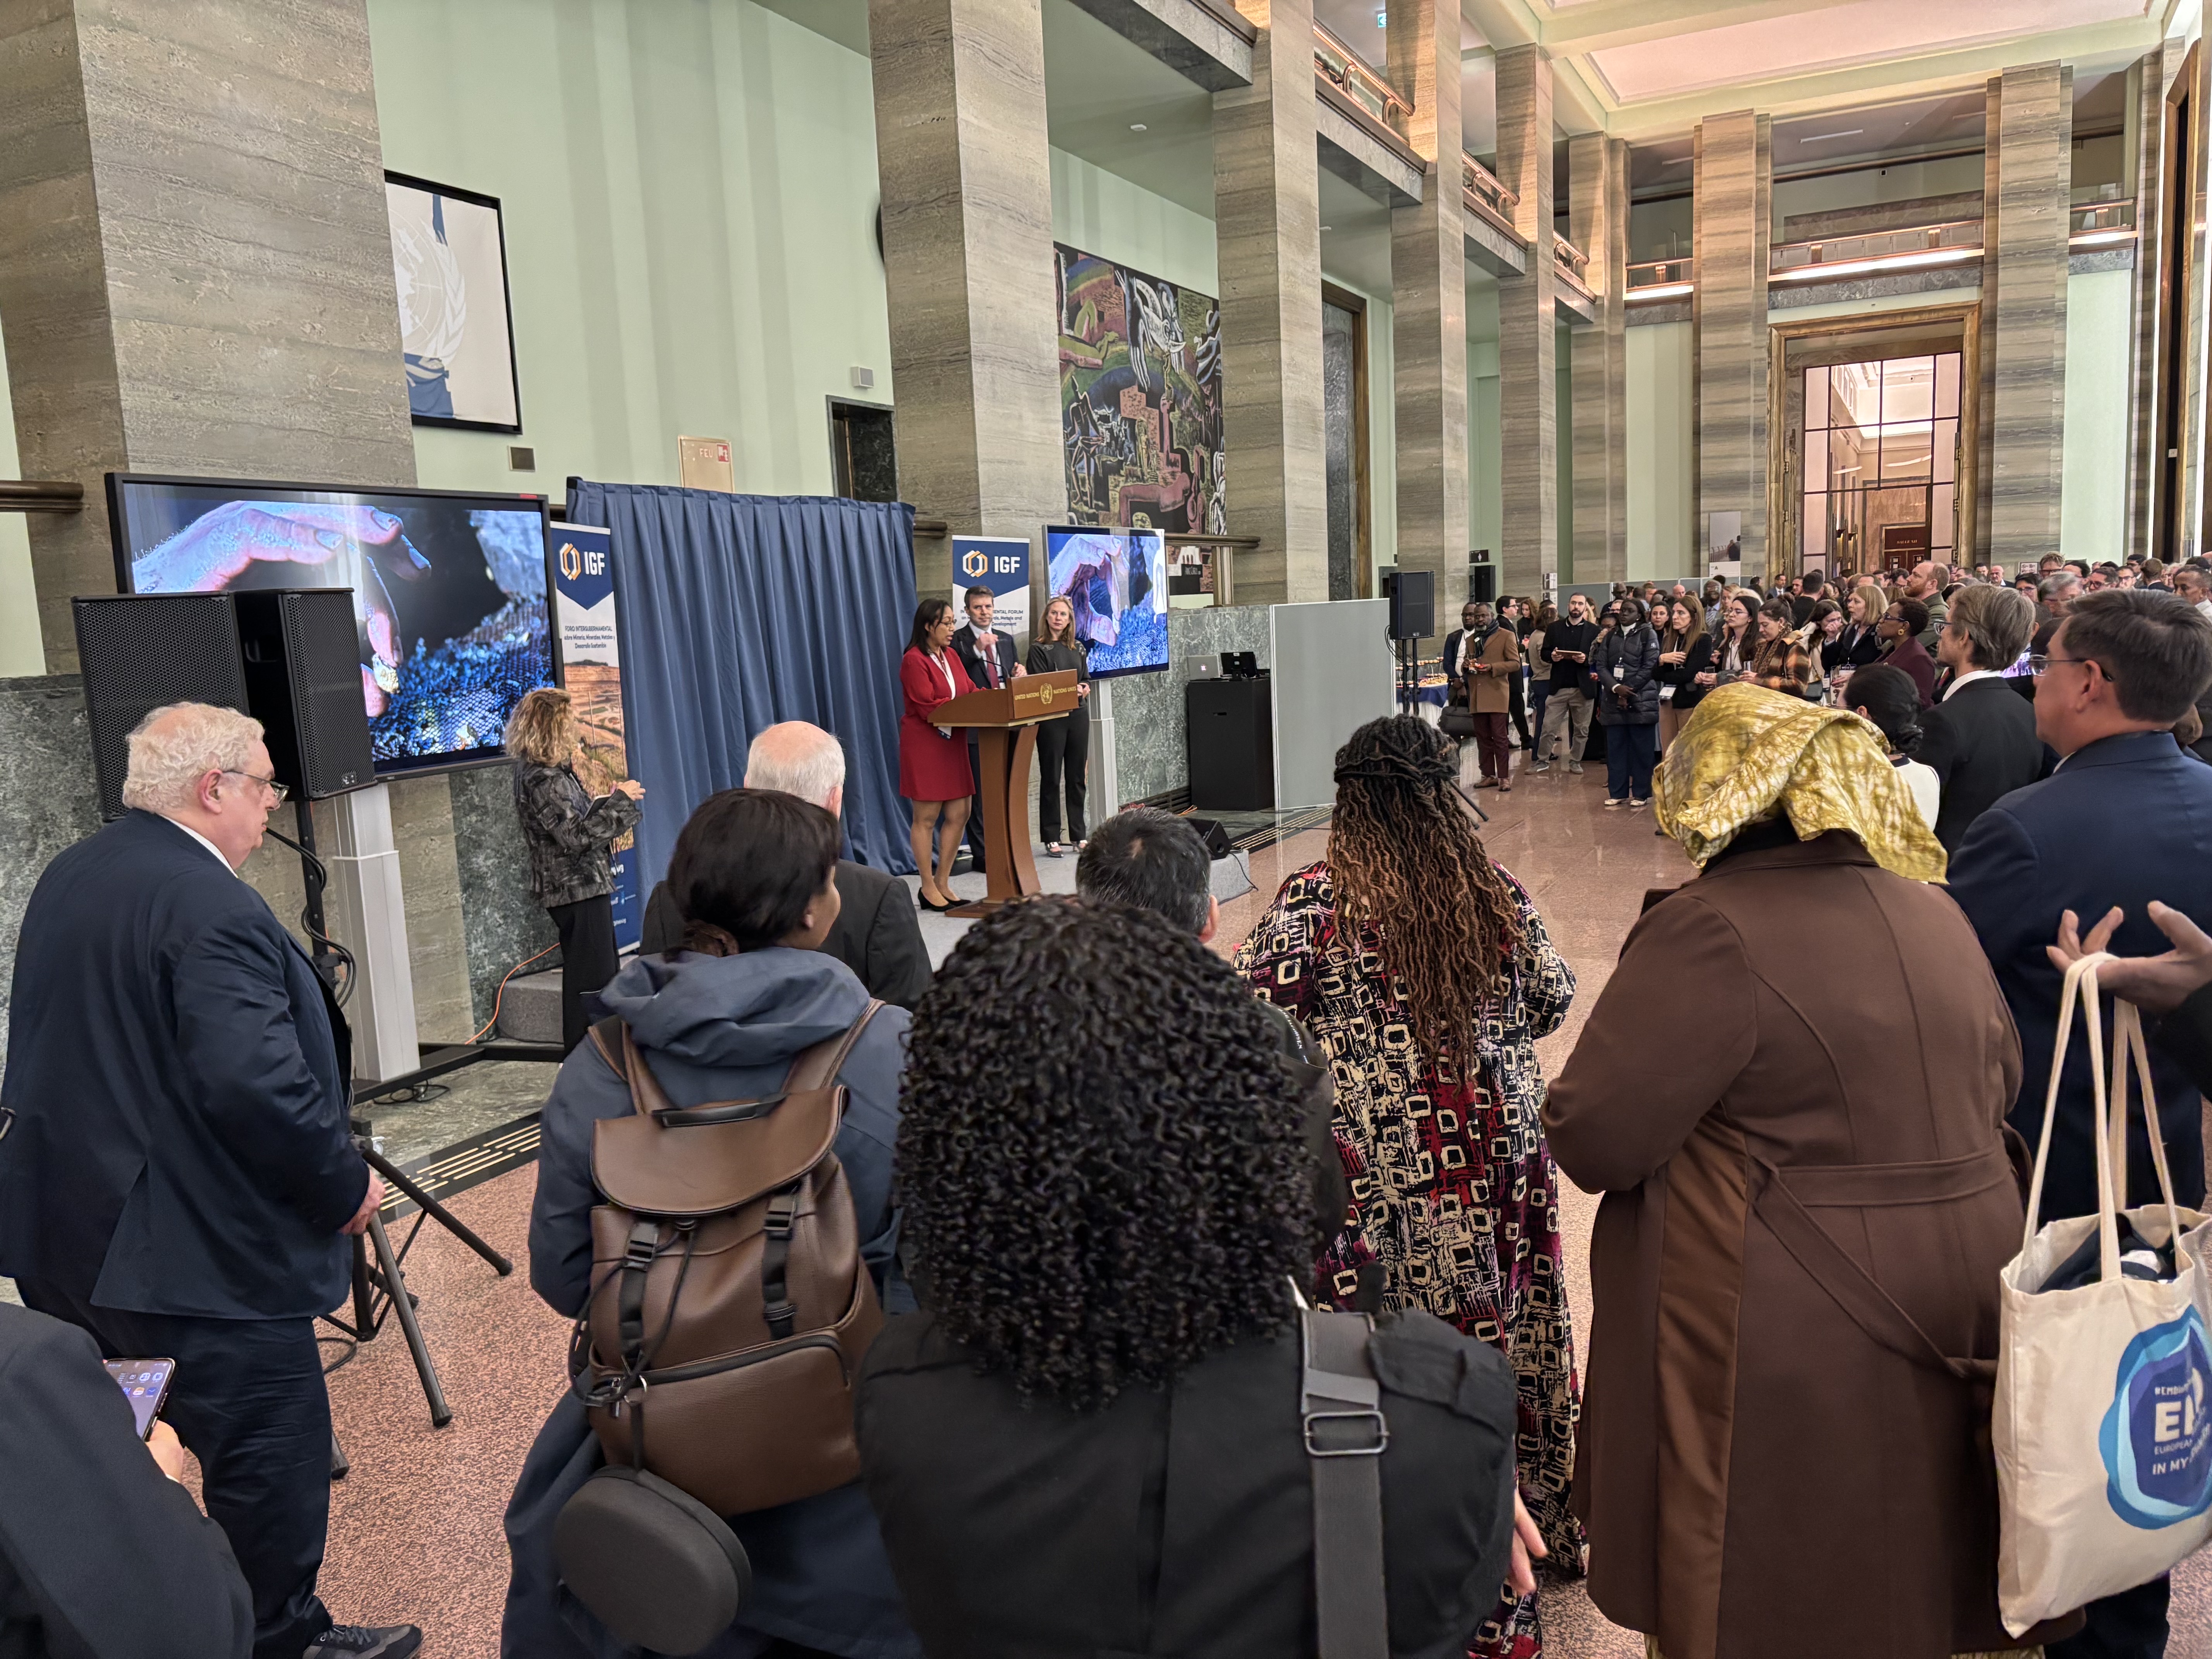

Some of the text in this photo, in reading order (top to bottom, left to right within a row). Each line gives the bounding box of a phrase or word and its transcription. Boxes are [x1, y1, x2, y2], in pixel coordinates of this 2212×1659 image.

[699, 448, 713, 458] FEU
[584, 551, 605, 575] IGF
[994, 556, 1020, 573] IGF
[2153, 1456, 2188, 1475] IN MY
